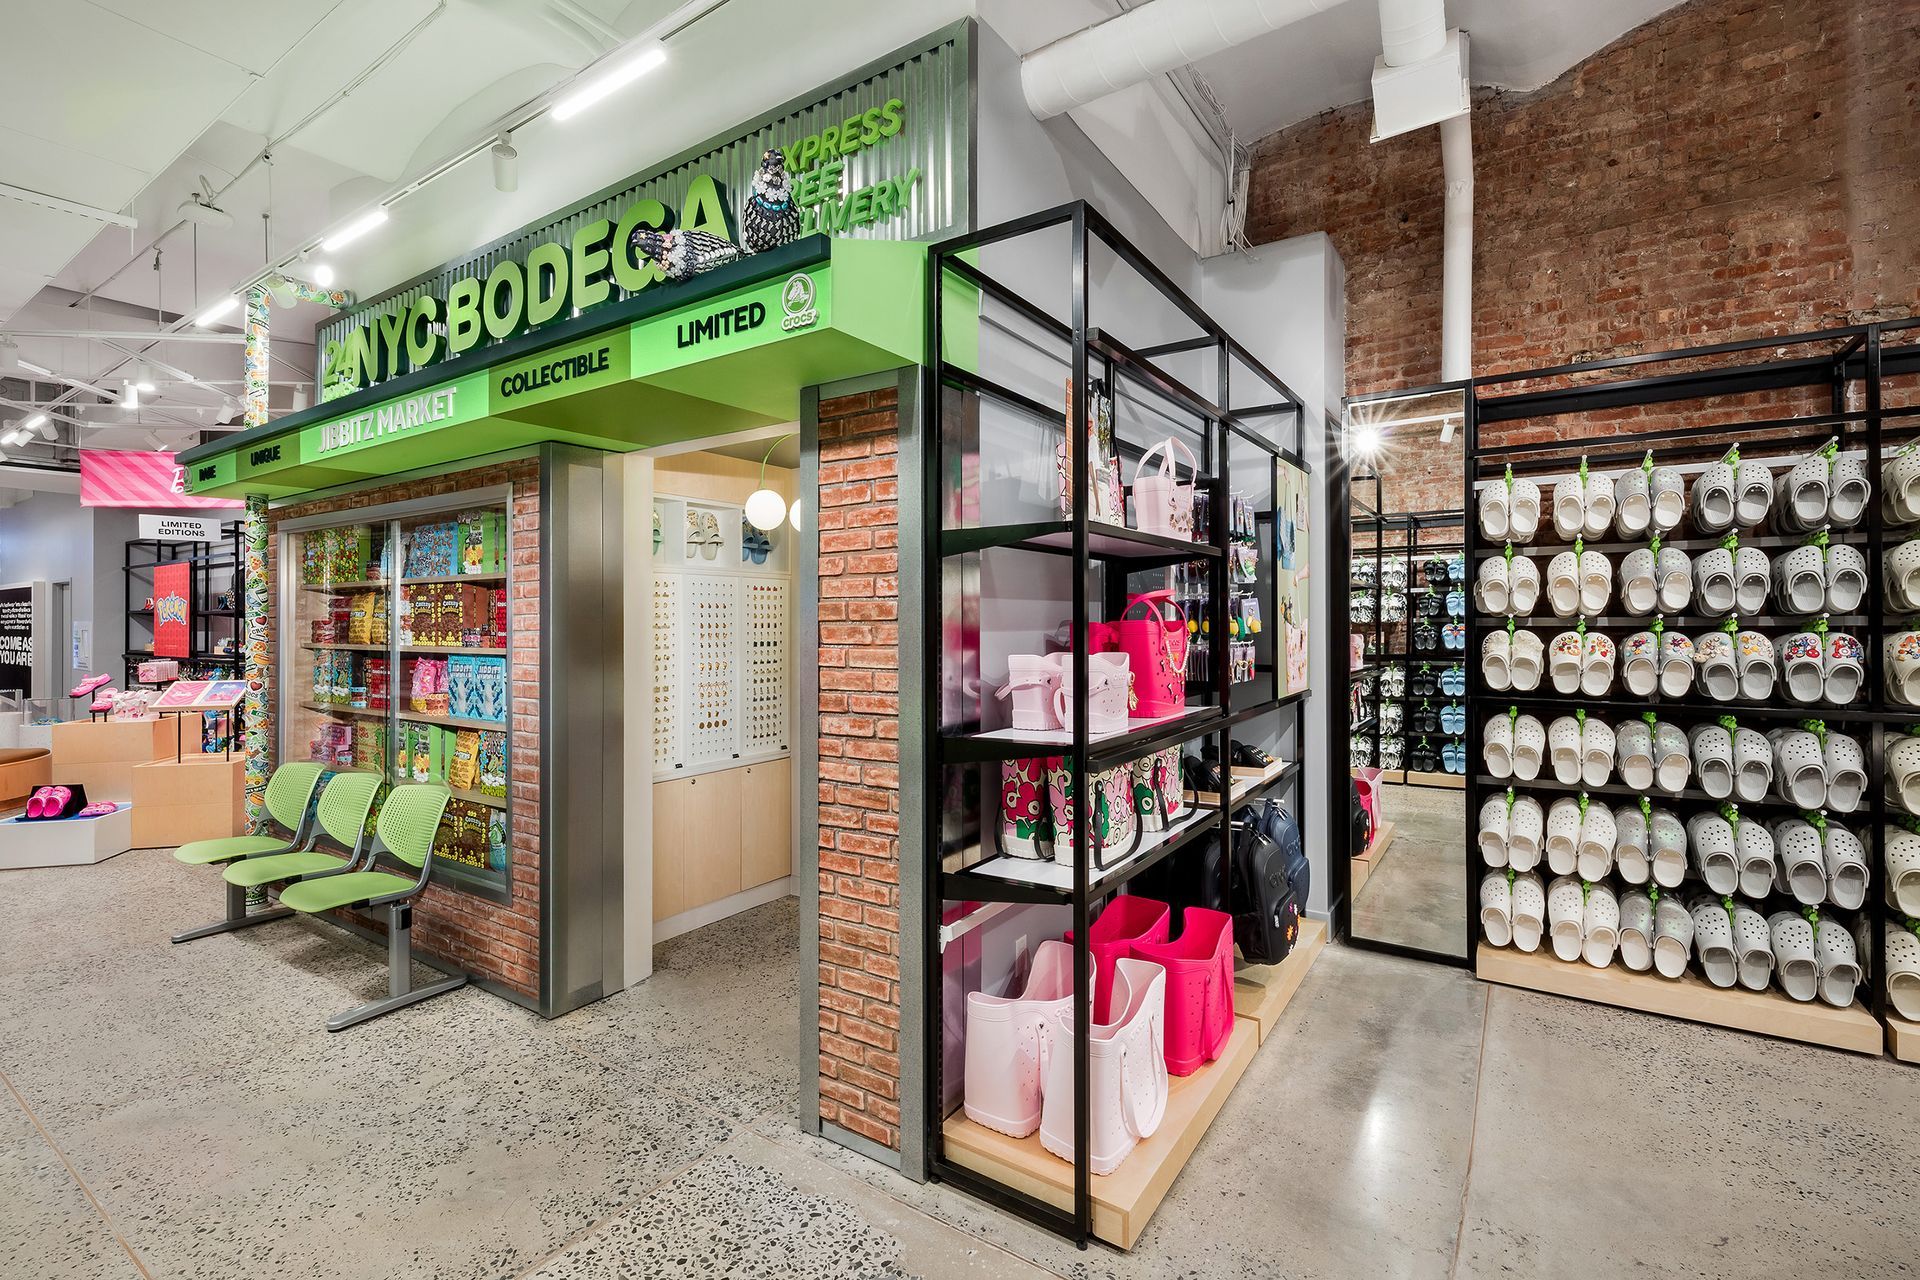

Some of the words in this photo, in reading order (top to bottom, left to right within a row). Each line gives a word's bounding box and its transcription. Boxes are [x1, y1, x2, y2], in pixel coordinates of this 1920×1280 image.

[782, 98, 904, 173] XPRESS
[352, 295, 446, 388] NYC
[449, 174, 735, 354] BODEGA
[677, 301, 766, 348] LIMITED
[783, 312, 812, 328] crocs
[501, 347, 609, 397] COLLECTIBLE
[320, 411, 374, 453] JIBBITZ
[377, 387, 456, 436] MARKET
[250, 445, 281, 466] UNIQUE
[158, 528, 206, 537] EDITIONS
[161, 520, 202, 529] LIMITED
